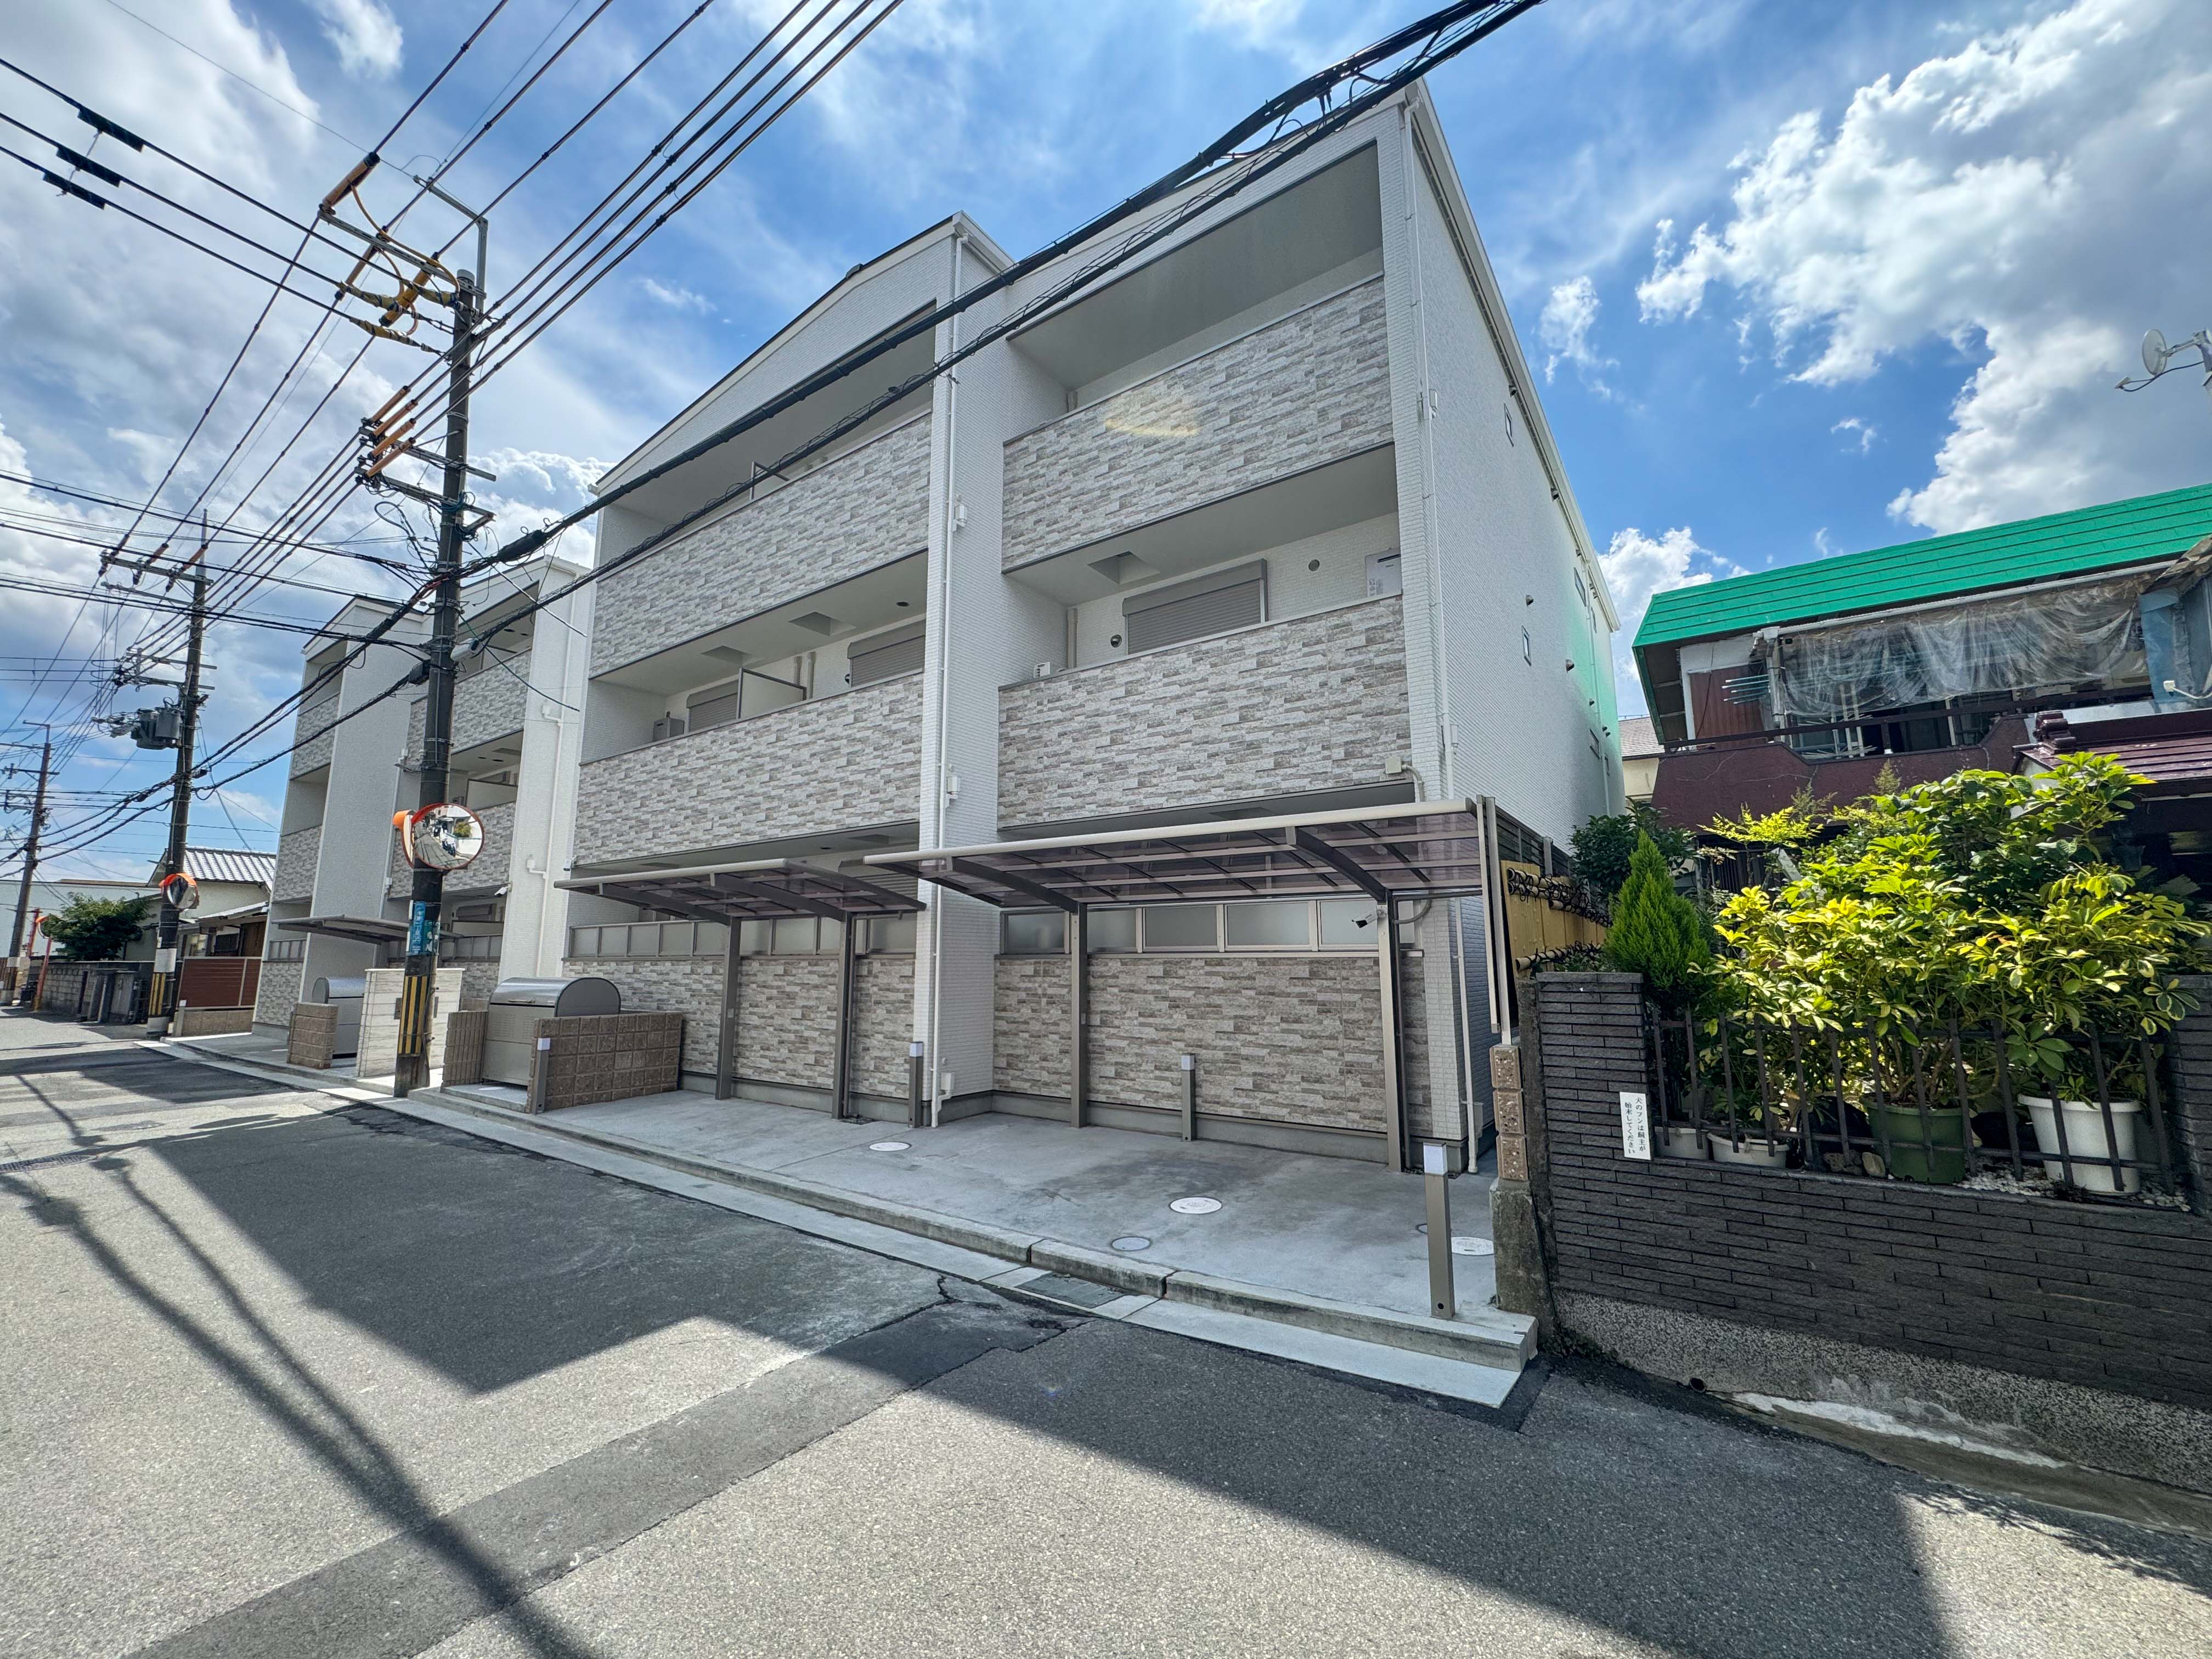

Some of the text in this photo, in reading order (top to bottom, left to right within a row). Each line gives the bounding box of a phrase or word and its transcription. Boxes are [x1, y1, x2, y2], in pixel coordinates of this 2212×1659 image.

[1624, 1102, 1635, 1154] 始末してください
[1635, 1097, 1646, 1151] 犬のフンは飼主が
